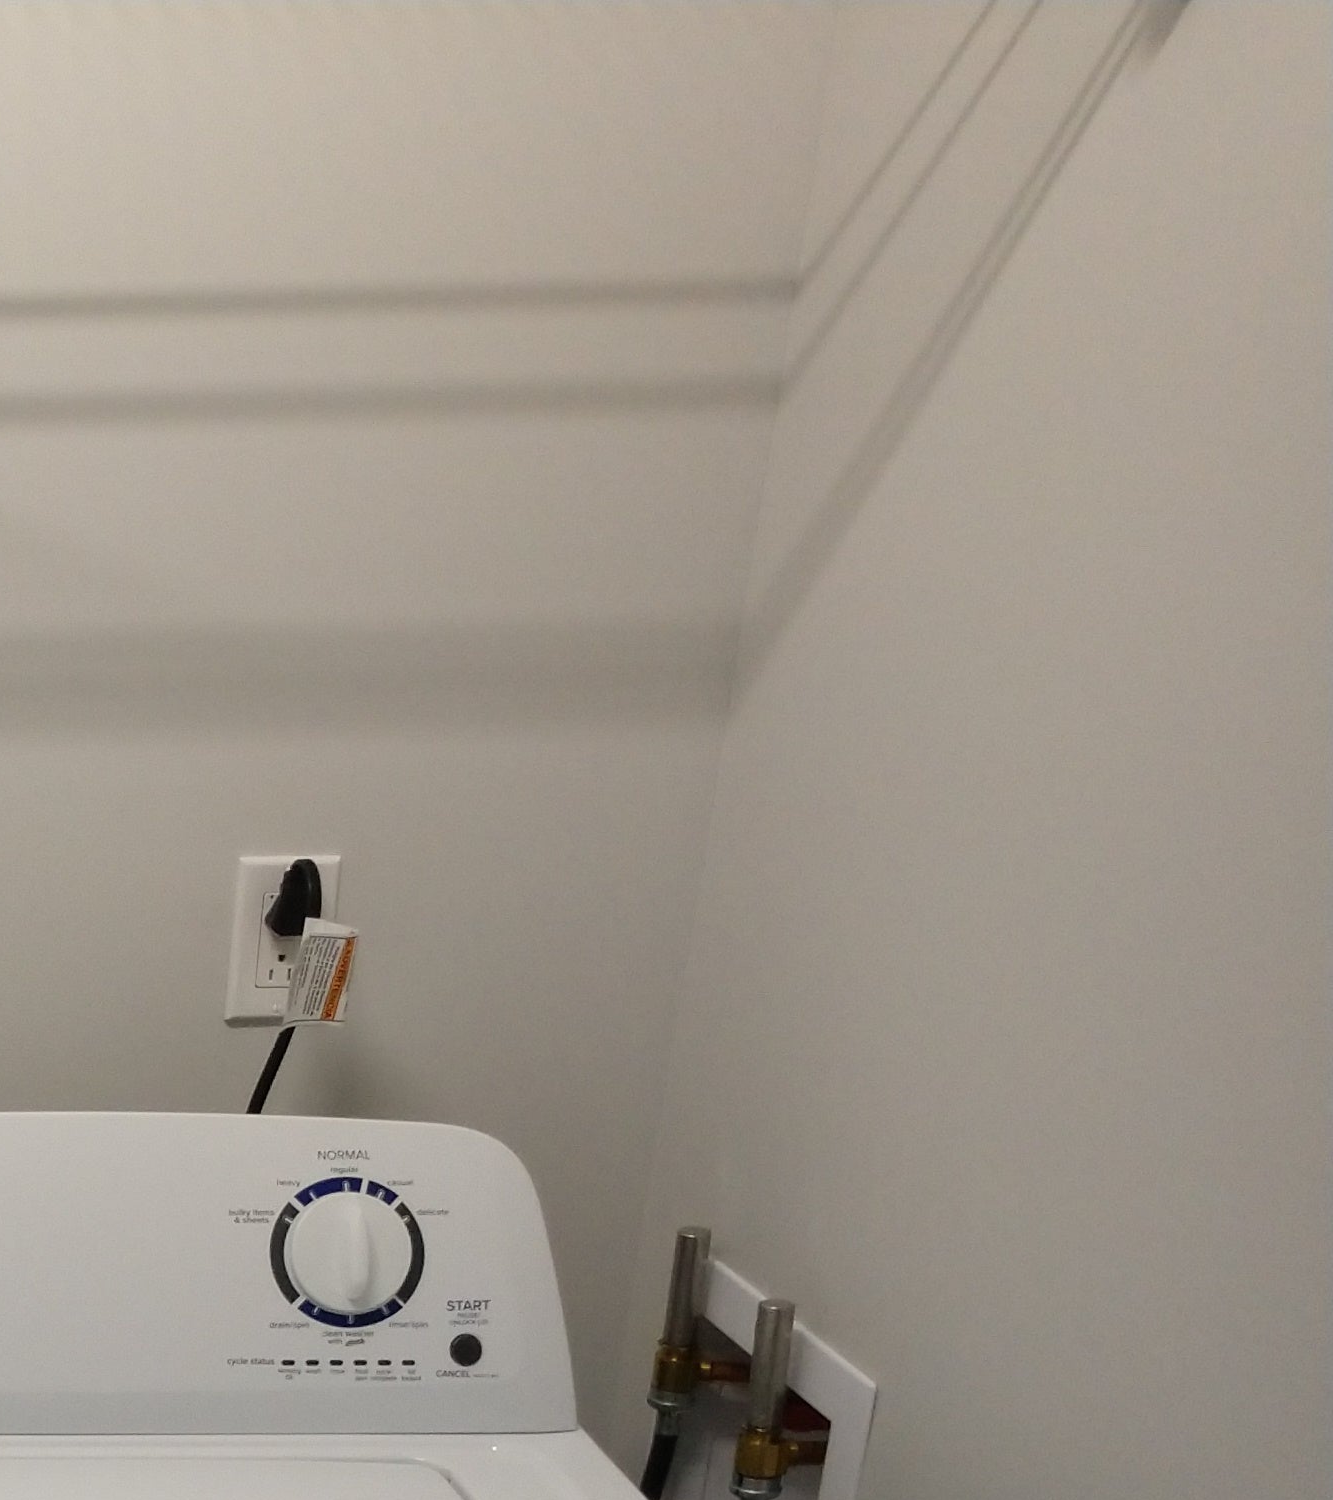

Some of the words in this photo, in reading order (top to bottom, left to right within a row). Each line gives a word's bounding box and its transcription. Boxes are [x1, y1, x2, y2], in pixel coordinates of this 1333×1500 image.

[317, 1150, 370, 1161] NORMAL
[446, 1300, 491, 1311] START
[250, 1357, 275, 1365] status
[436, 1369, 471, 1378] CANCEL
